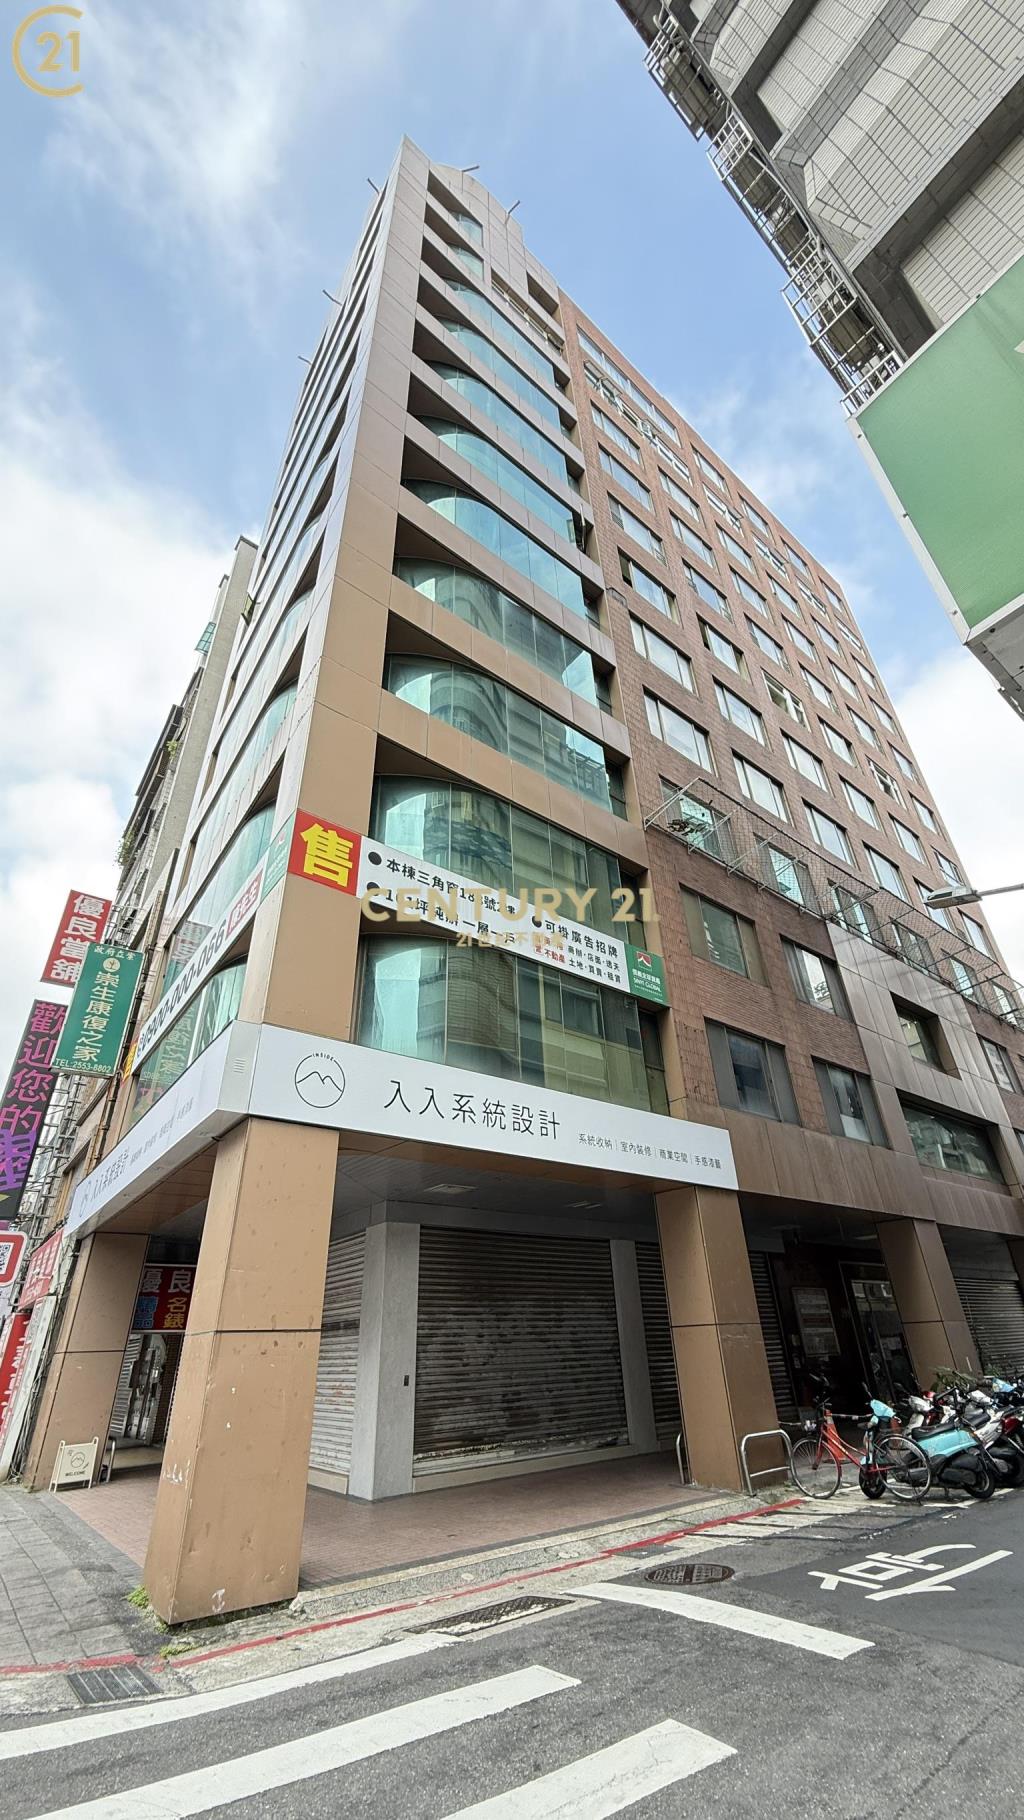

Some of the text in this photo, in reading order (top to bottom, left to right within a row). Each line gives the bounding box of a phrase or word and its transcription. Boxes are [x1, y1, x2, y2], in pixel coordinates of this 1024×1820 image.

[300, 823, 354, 887] 售
[545, 920, 619, 958] 可掛廣告招牌
[384, 1080, 561, 1140] 入入系統設計
